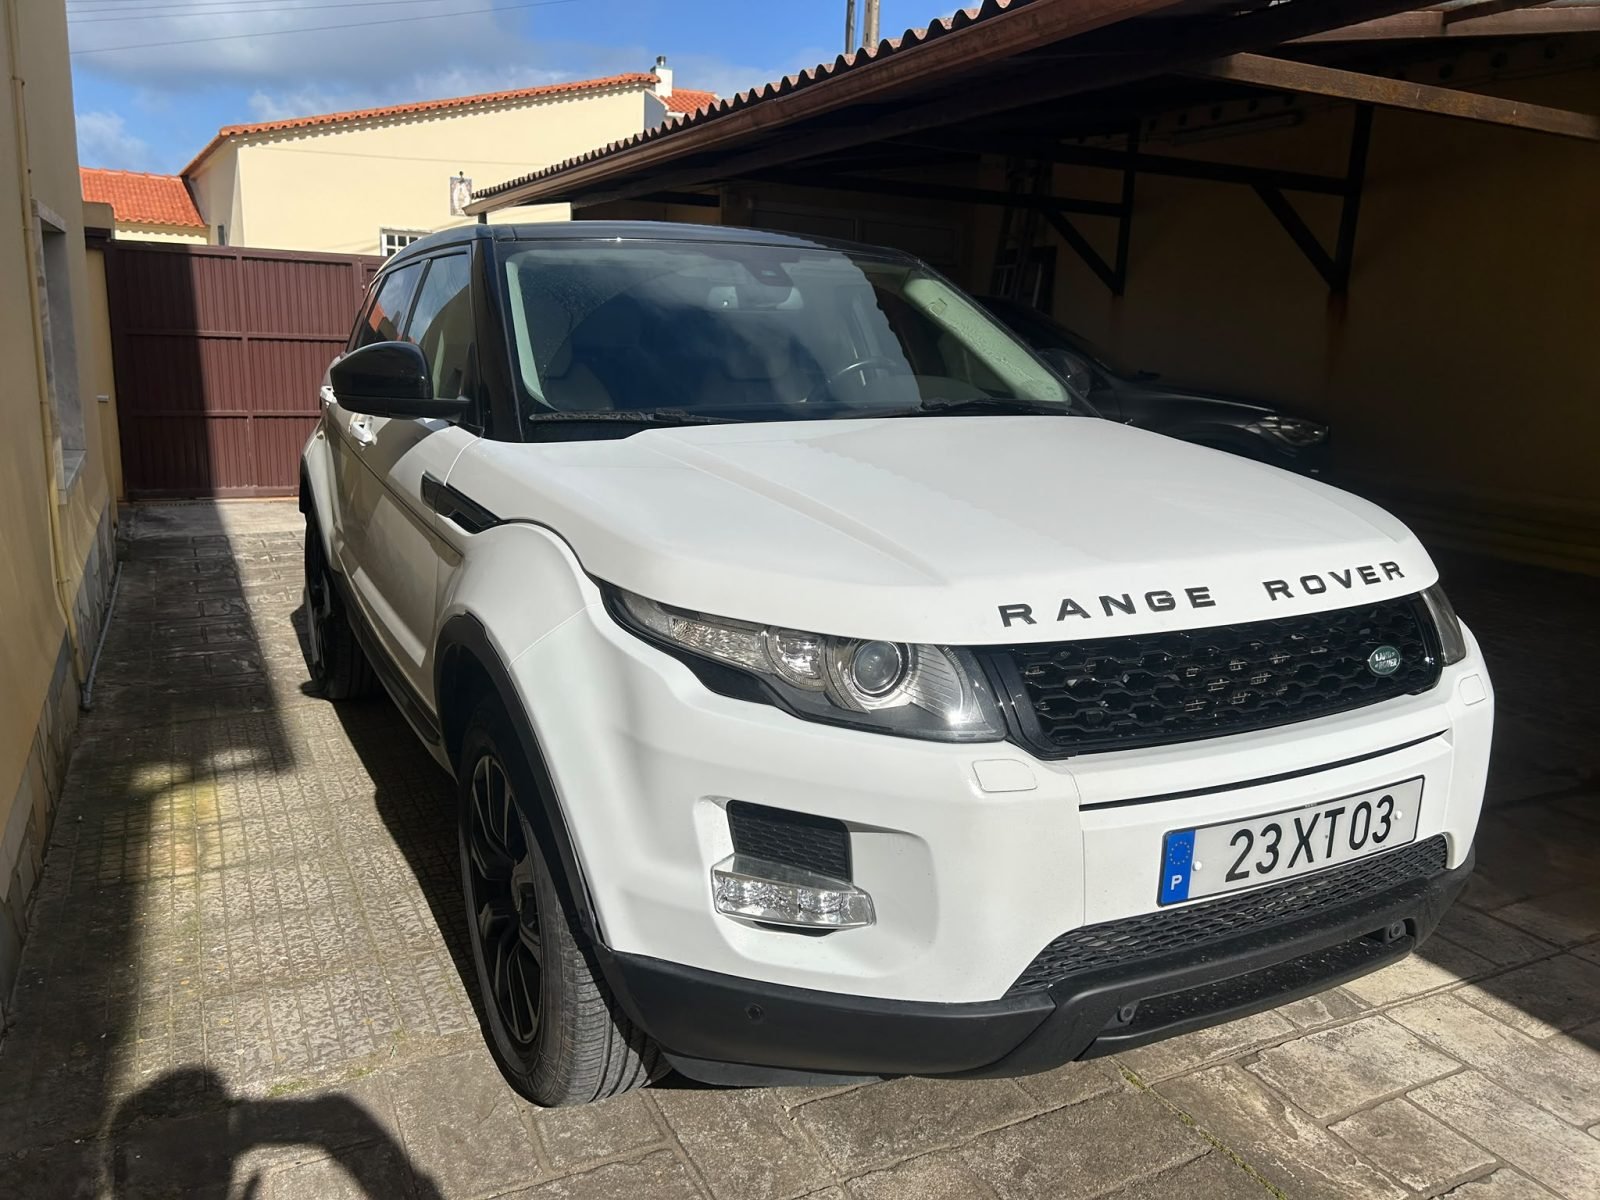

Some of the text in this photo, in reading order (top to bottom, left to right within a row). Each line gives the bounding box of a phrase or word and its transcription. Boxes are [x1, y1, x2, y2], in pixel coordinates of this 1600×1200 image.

[998, 561, 1405, 628] RANGE ROVER
[1170, 874, 1183, 891] P
